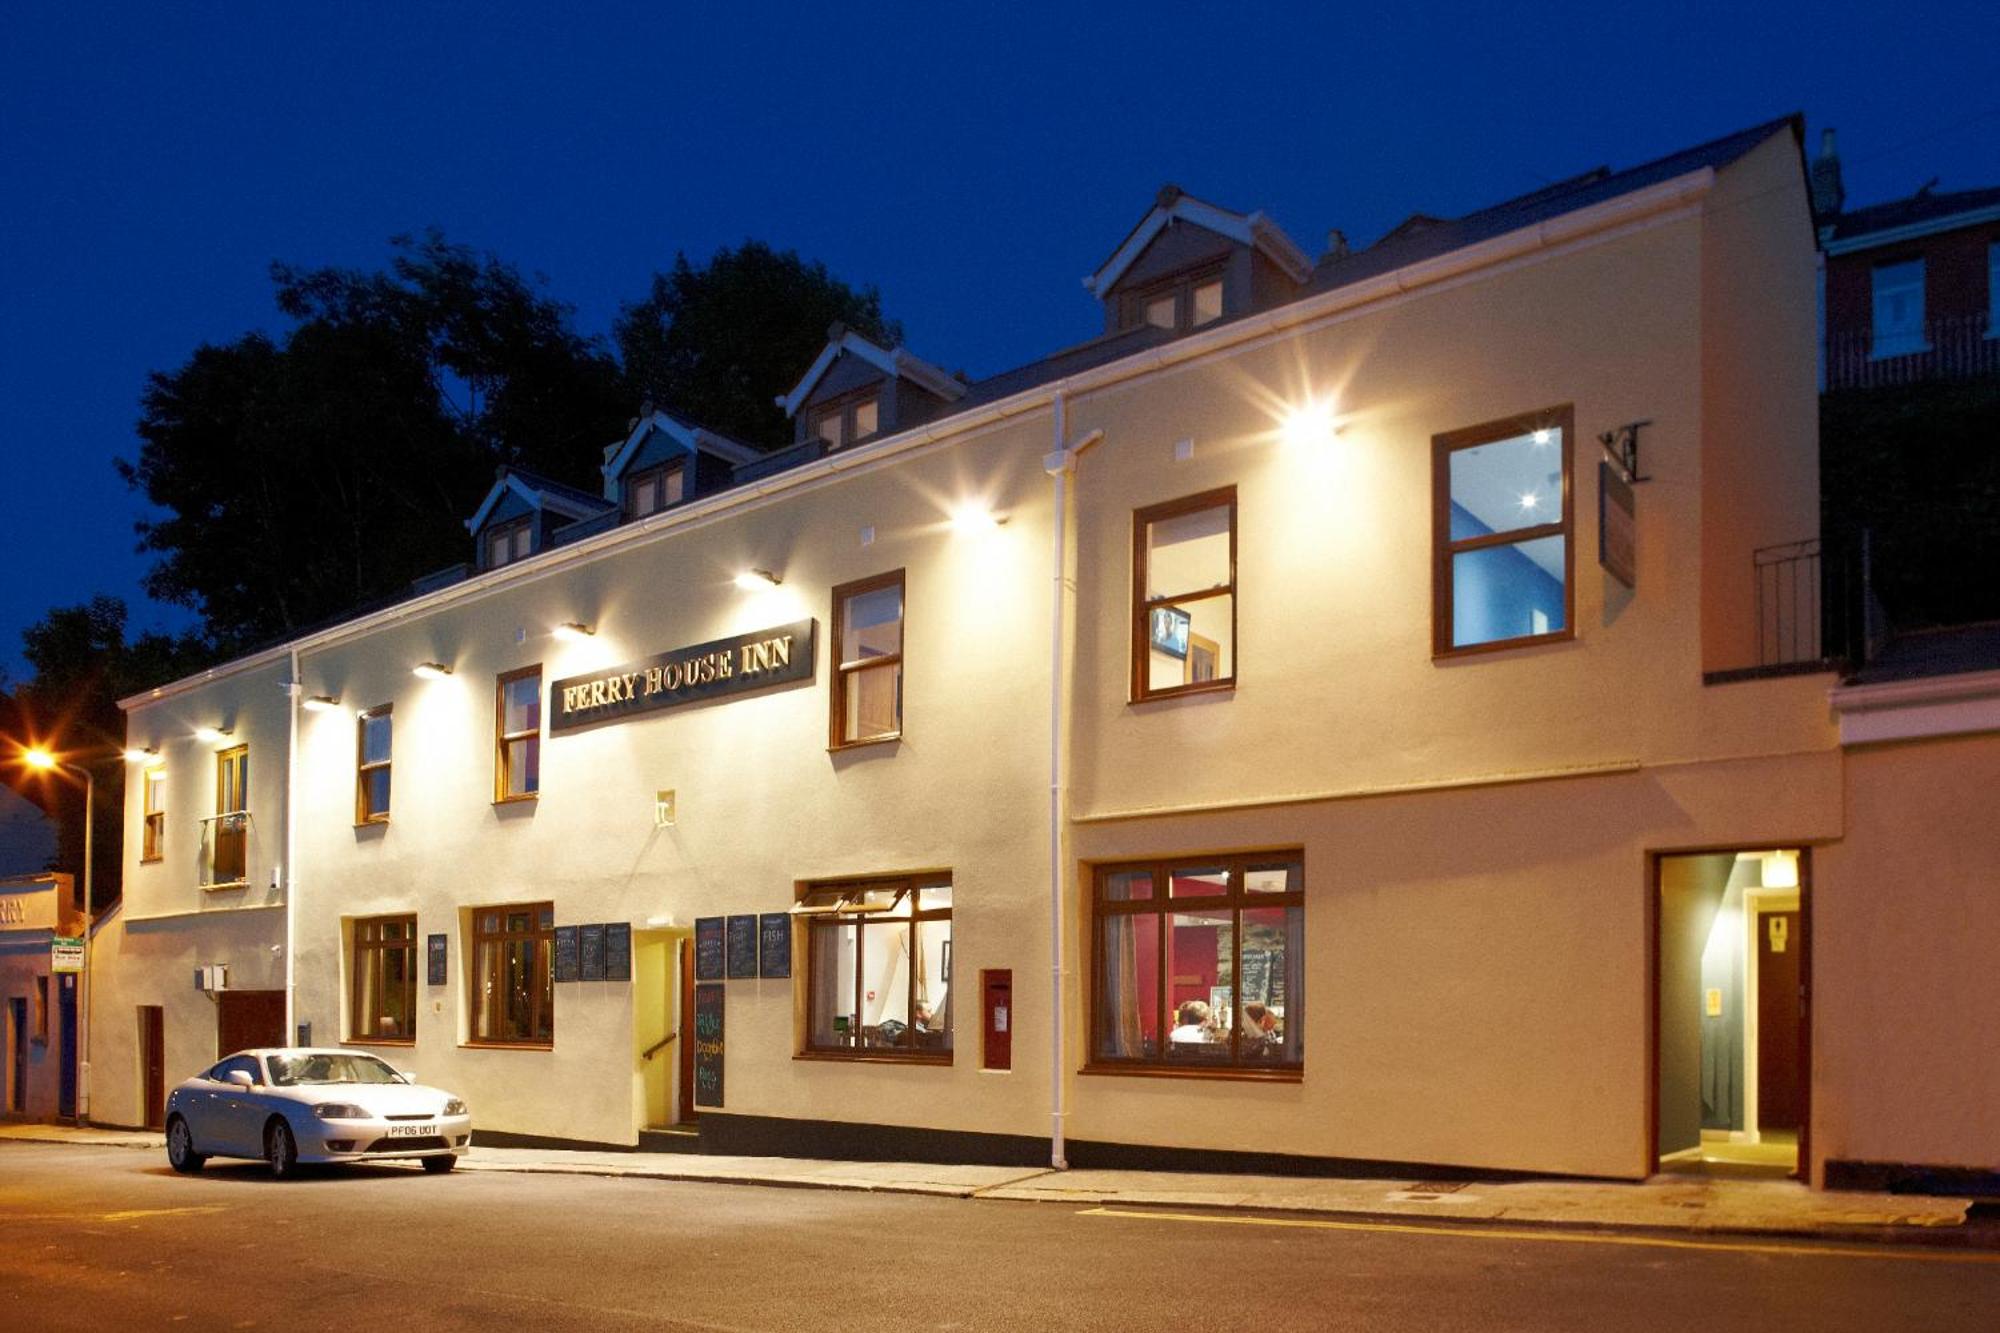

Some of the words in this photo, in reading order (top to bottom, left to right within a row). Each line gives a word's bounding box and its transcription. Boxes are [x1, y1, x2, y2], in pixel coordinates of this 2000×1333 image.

[562, 672, 638, 713] FERRY
[643, 650, 732, 697] HOUSE
[740, 636, 792, 674] INN
